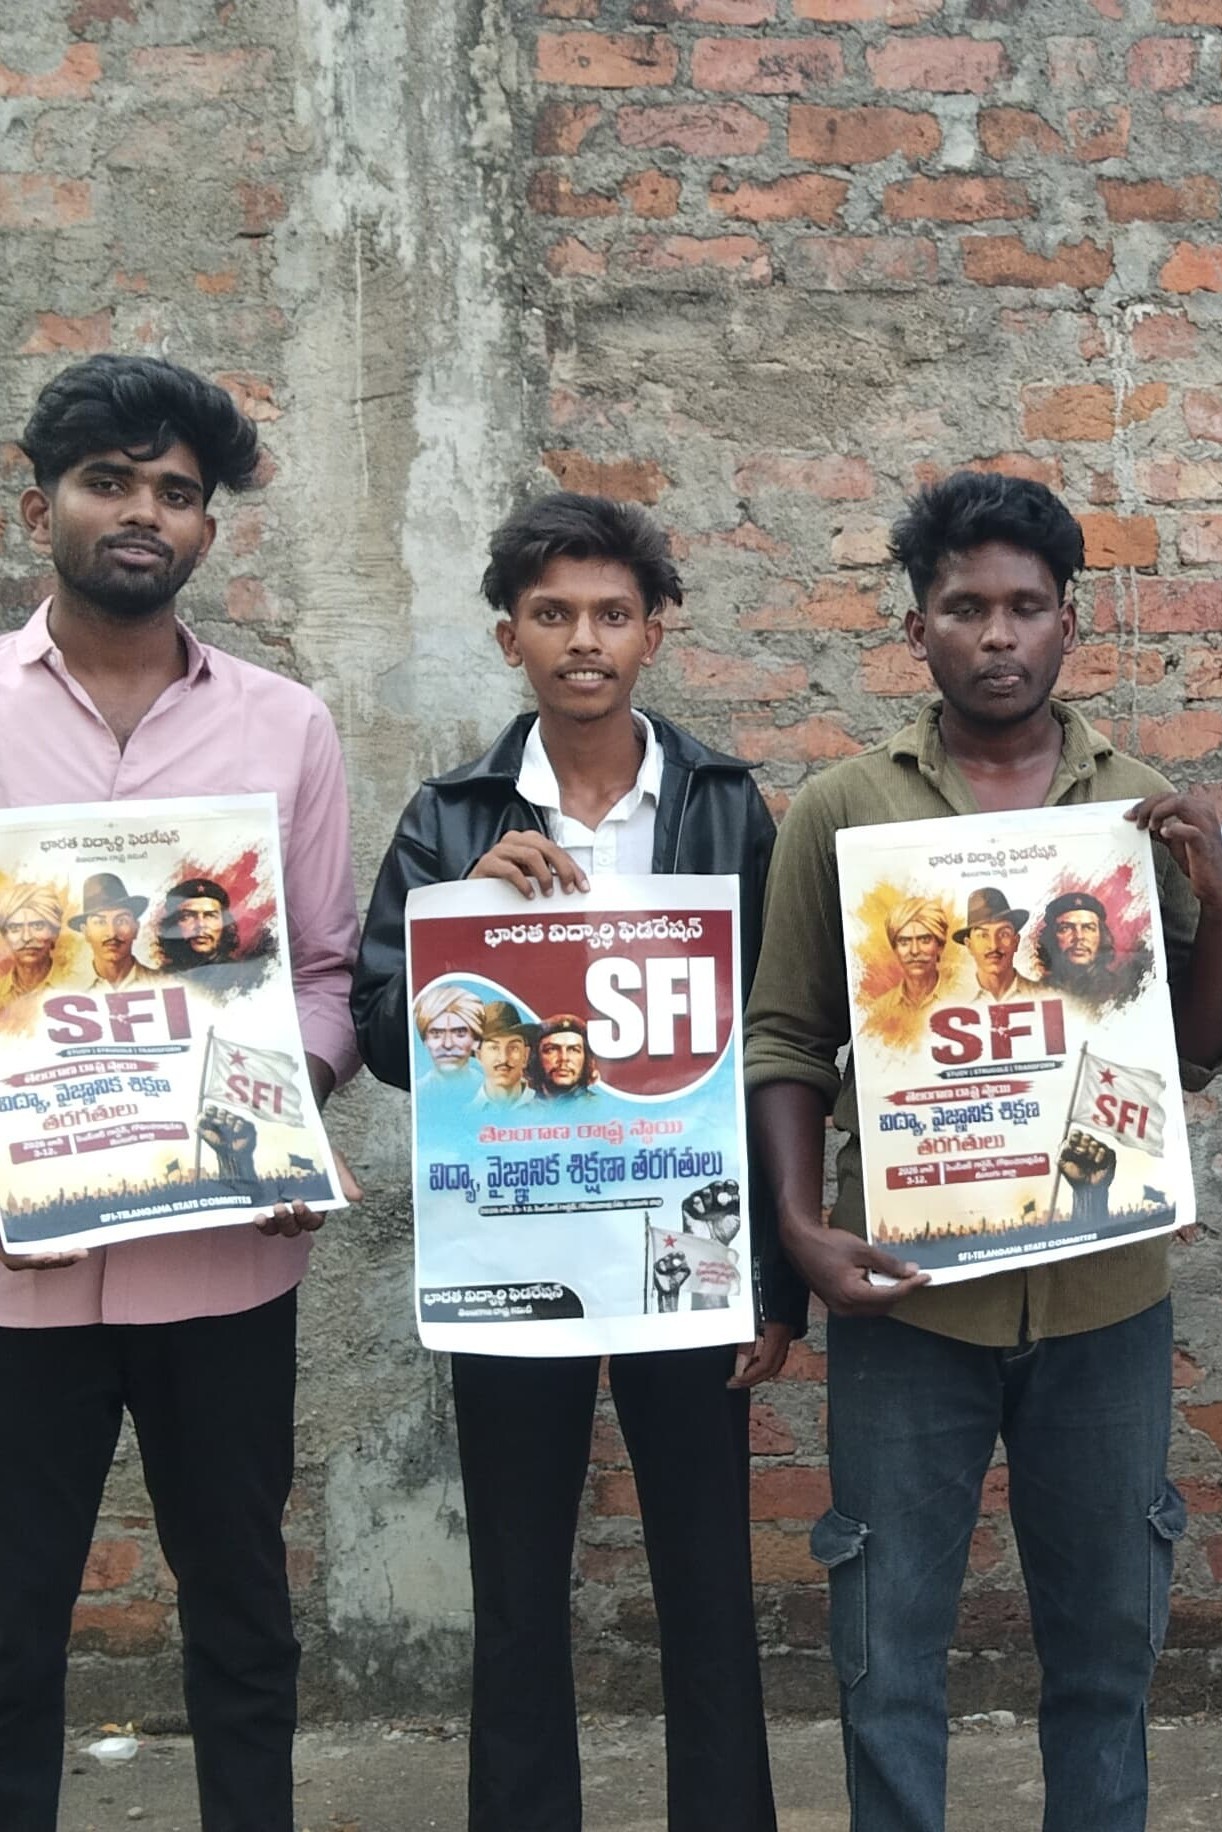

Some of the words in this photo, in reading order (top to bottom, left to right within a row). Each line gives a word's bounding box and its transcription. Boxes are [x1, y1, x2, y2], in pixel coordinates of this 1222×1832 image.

[485, 923, 544, 947] భారత
[549, 921, 614, 949] విద్యార్థి
[618, 916, 703, 942] ఫెడరేషన్
[43, 986, 192, 1045] SFI
[585, 956, 718, 1059] SFI
[928, 998, 1067, 1065] SFI
[225, 1074, 284, 1115] SFI
[43, 1103, 139, 1130] తరగతులు
[1093, 1093, 1150, 1139] SFI
[478, 1125, 571, 1144] తెలంగాణ
[917, 1134, 1005, 1155] తరగతులు
[487, 1153, 560, 1202] వైజ్ఞానిక
[632, 1148, 723, 1184] తరగతులు
[173, 1199, 198, 1211] STATE
[1024, 1241, 1047, 1252] STATE
[424, 1290, 461, 1306] భారత
[509, 1284, 563, 1301] ఫెడరేషన్
